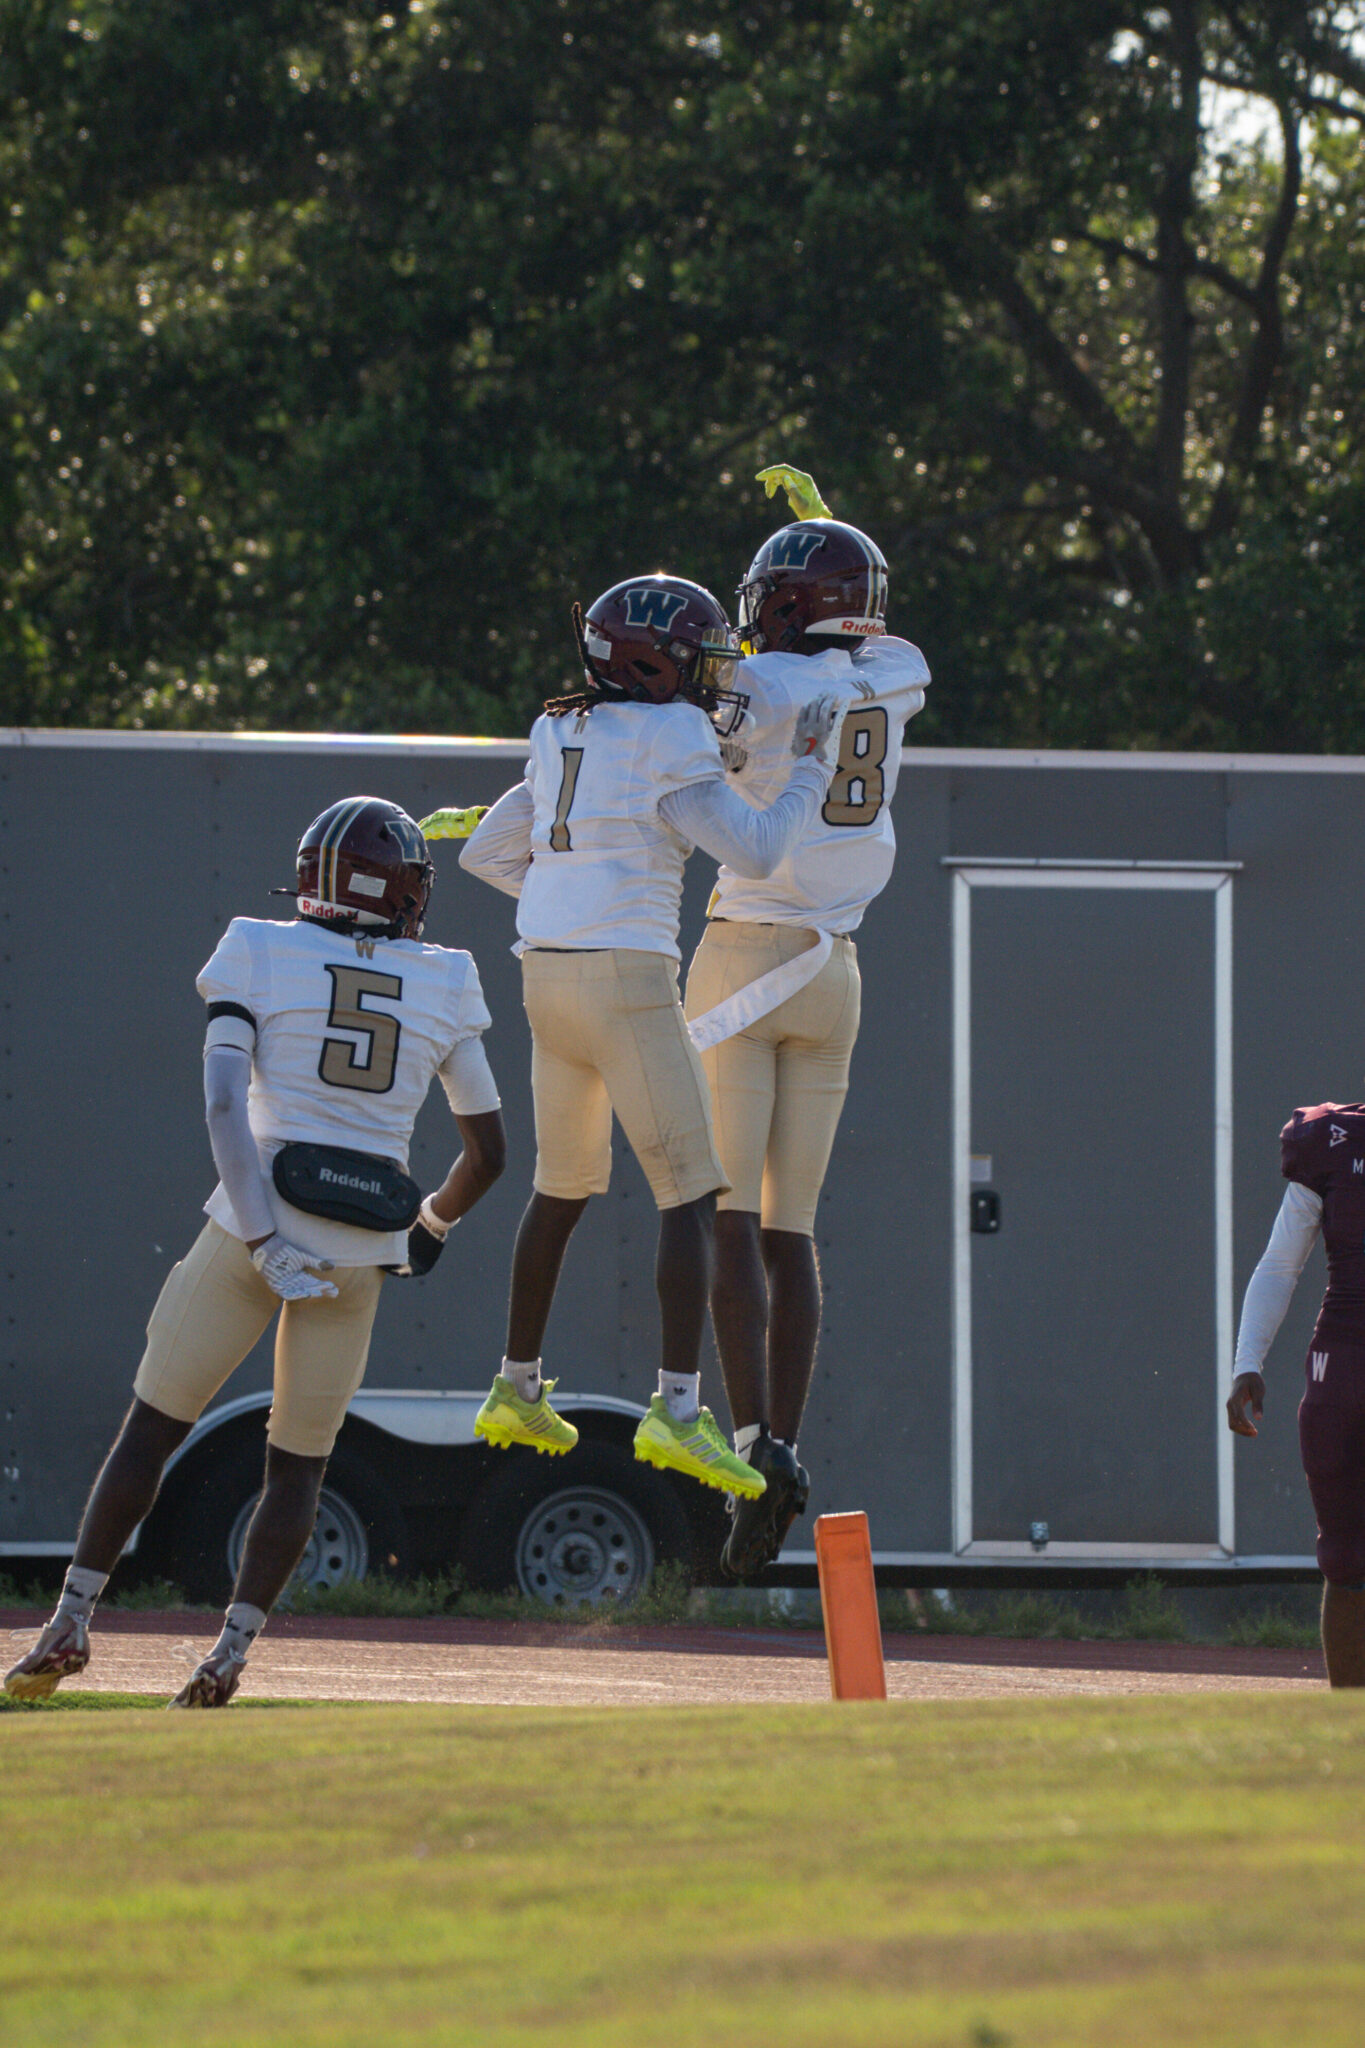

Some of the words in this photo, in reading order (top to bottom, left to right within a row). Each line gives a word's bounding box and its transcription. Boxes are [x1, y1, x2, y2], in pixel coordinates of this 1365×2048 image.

[768, 532, 826, 570] W
[624, 588, 688, 633] W
[821, 706, 889, 826] 8
[549, 746, 585, 852] 1
[355, 940, 376, 960] W
[318, 963, 403, 1093] 5
[319, 1167, 382, 1195] Riddell
[1312, 1351, 1330, 1383] W
